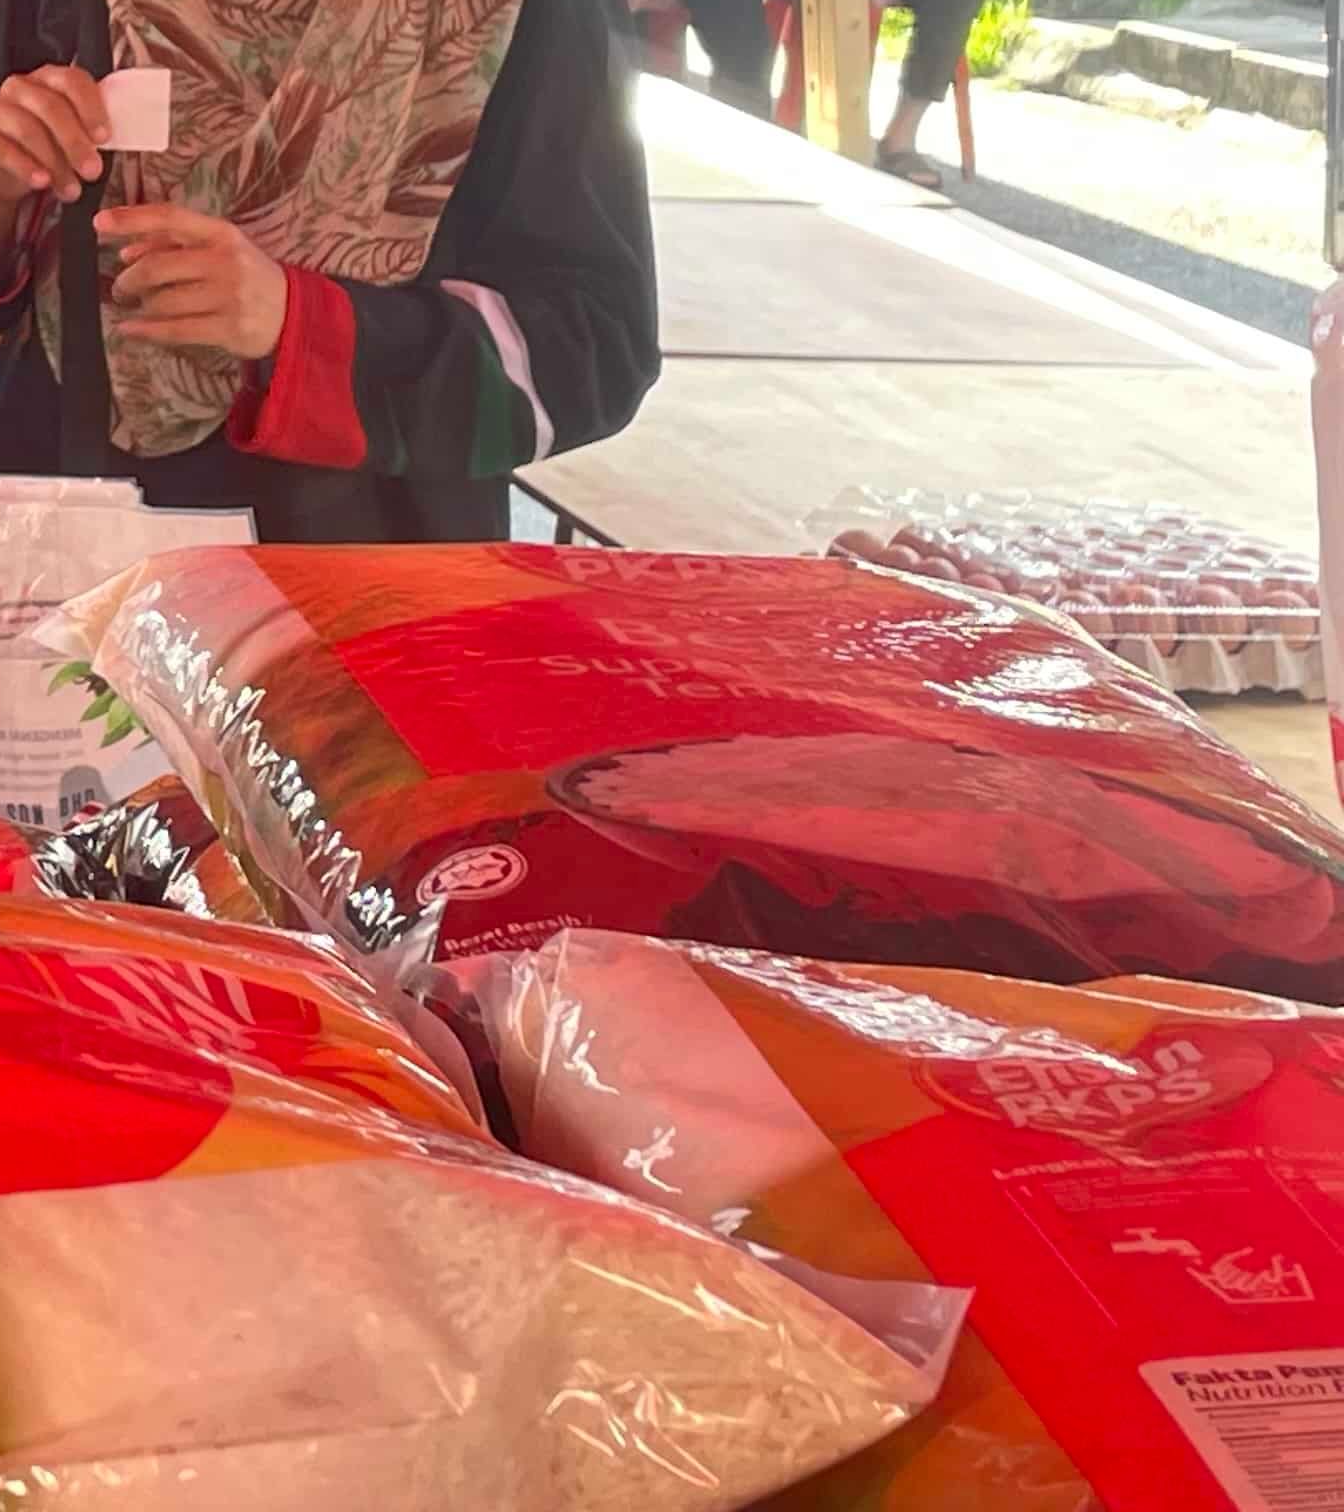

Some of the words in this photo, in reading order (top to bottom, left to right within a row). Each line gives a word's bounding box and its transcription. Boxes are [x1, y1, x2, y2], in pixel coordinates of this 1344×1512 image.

[443, 928, 503, 951] Berat
[508, 913, 582, 935] Bersih
[995, 1068, 1214, 1128] PKPS
[1171, 1368, 1274, 1386] Fakta
[1186, 1381, 1327, 1402] Nutrition
